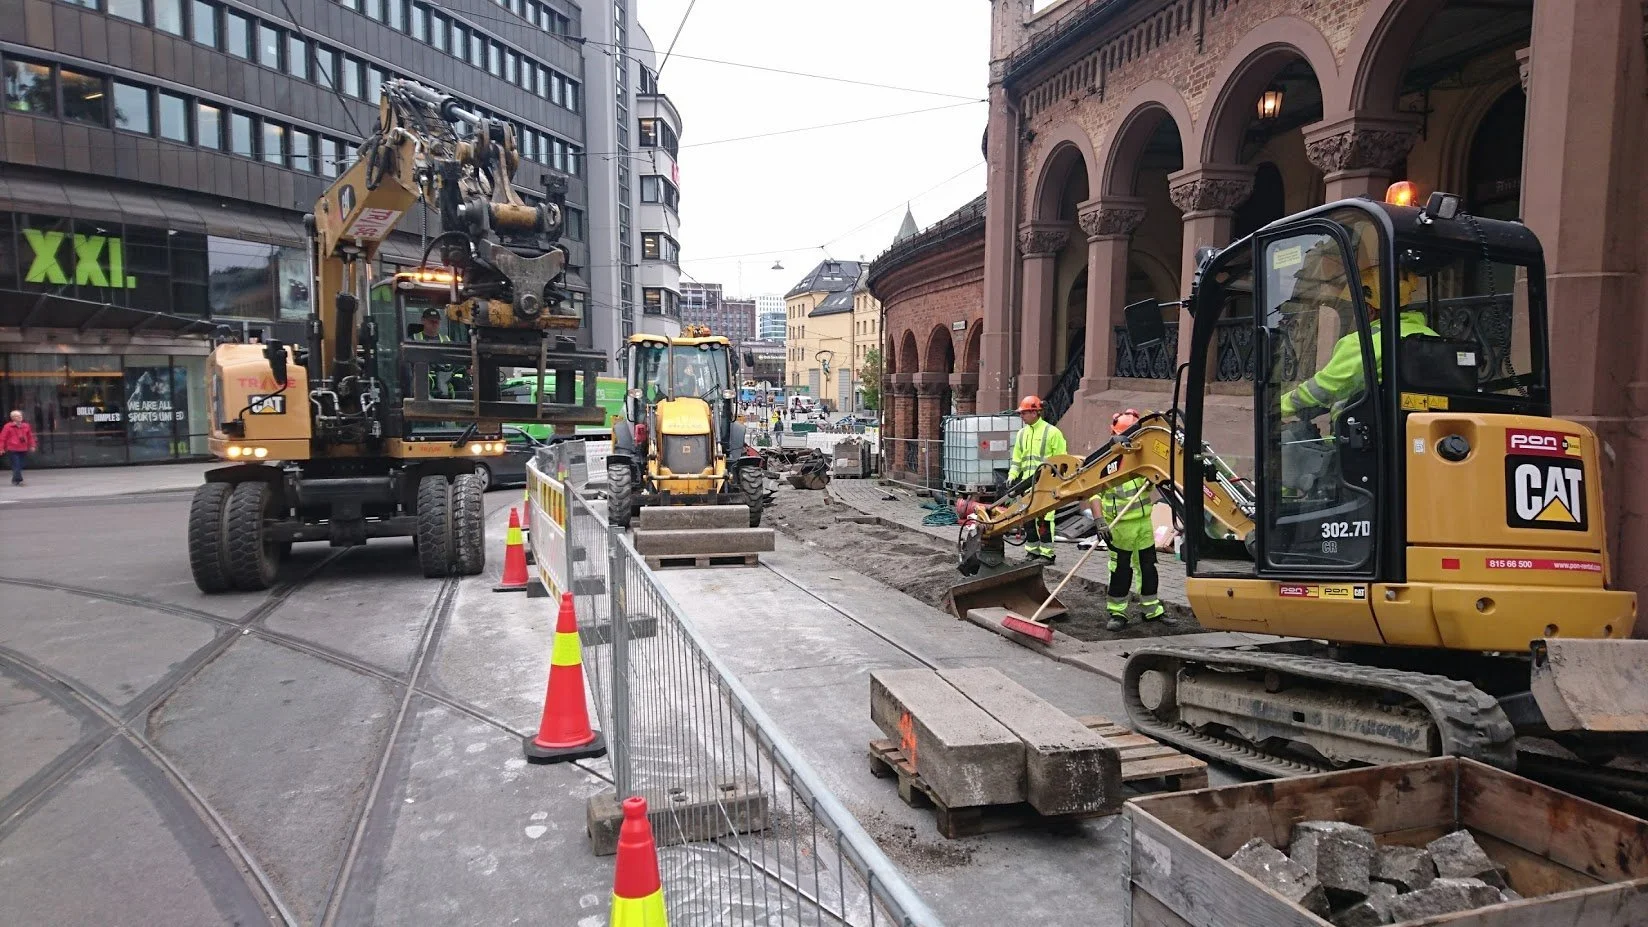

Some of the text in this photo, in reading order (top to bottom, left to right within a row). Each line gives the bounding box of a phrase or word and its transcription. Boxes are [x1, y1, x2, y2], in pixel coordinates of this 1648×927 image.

[128, 400, 172, 411] WE ARE ALL
[251, 395, 283, 413] CAT
[128, 411, 184, 422] SPORTS UNIED
[1510, 434, 1558, 451] pon
[1106, 460, 1118, 475] CAT
[1515, 463, 1583, 523] CAT
[1321, 520, 1370, 538] 302.7D
[1321, 540, 1338, 554] CR
[1489, 559, 1533, 568] 815 66 500
[1280, 587, 1303, 595] pon
[1324, 588, 1348, 596] pon
[1354, 588, 1364, 597] CAT
